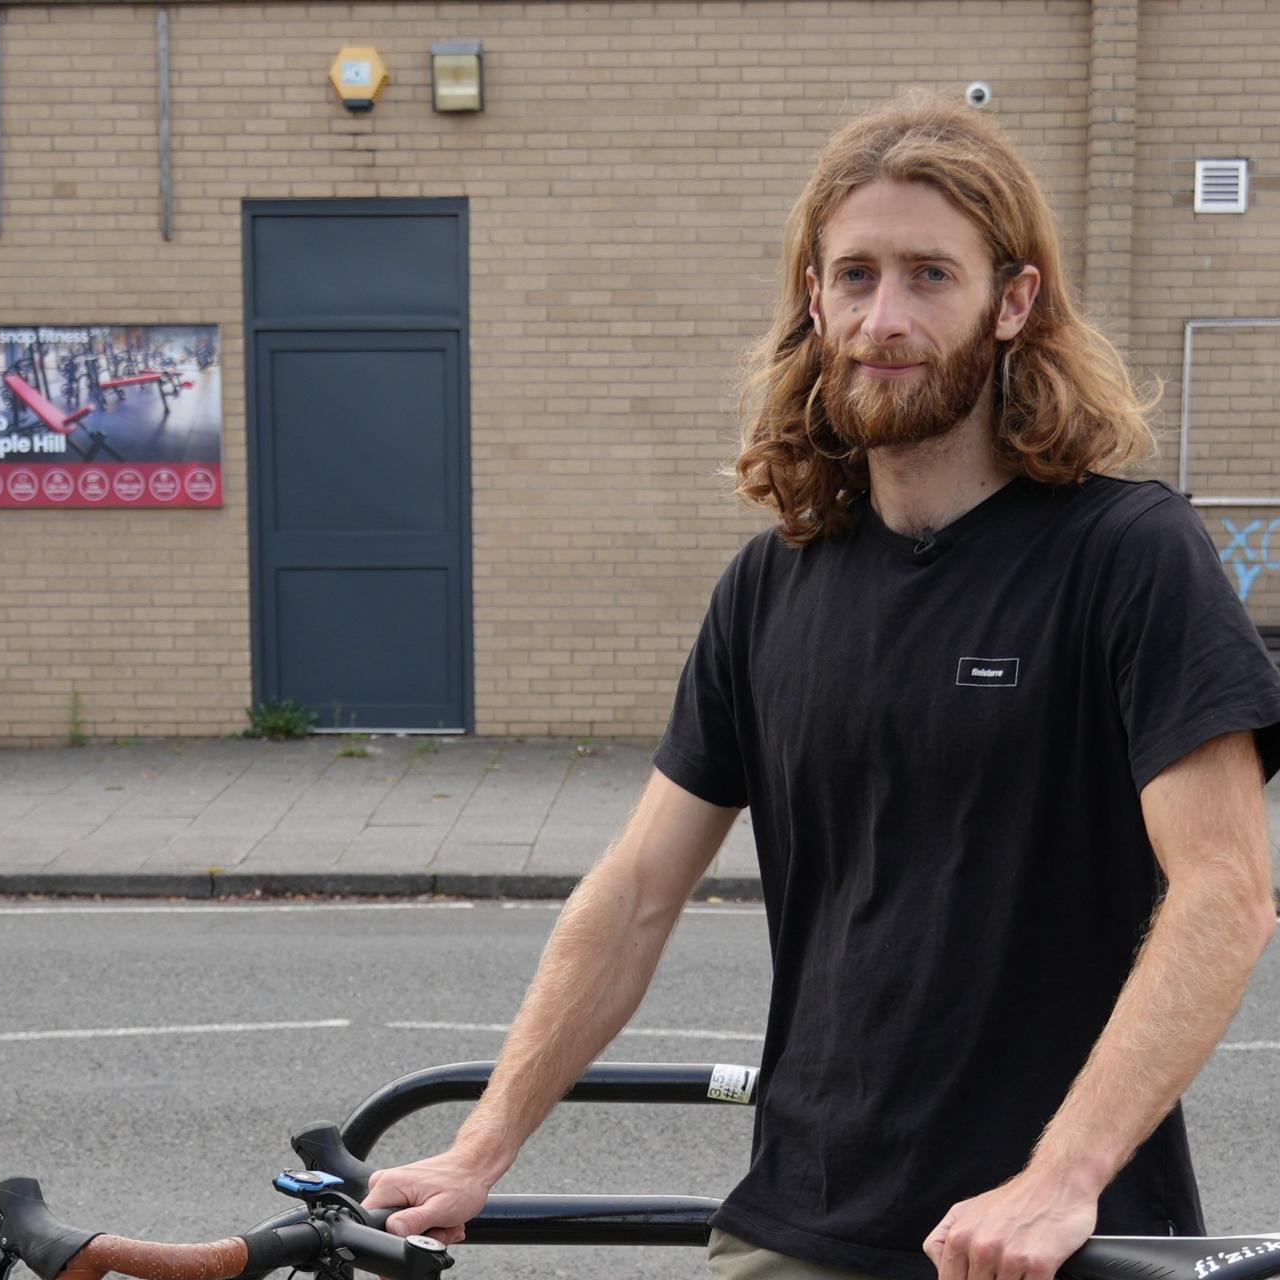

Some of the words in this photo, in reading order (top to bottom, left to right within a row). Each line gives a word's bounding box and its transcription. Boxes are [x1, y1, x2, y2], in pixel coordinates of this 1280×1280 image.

[0, 329, 37, 348] snap
[38, 327, 90, 343] fitness
[33, 433, 67, 454] Hill
